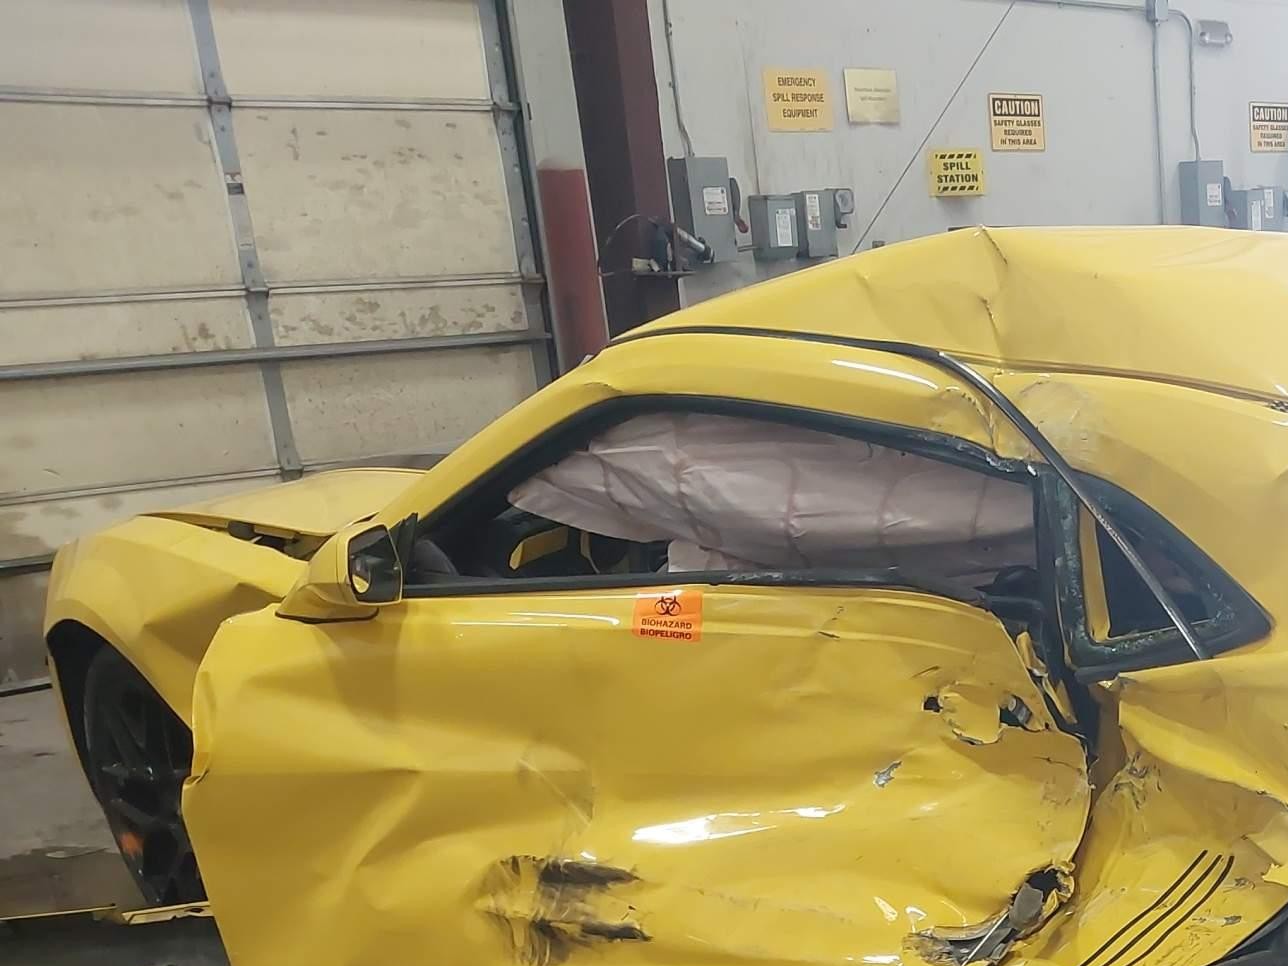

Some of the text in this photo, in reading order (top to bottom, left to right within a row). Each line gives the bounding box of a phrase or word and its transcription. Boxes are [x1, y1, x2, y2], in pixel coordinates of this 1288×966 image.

[777, 76, 816, 87] EMERGENCY
[772, 92, 825, 103] SPILL RESPONSE
[782, 108, 818, 118] EQUIPMENT
[994, 100, 1039, 116] CAUTION
[1254, 107, 1288, 121] CAUTION
[993, 119, 1041, 127] SAFETY GLASSES
[943, 161, 971, 171] SPILL
[936, 173, 979, 183] STATION
[641, 618, 692, 630] BIOHAZARD
[640, 628, 692, 640] BIOPELIGRO
